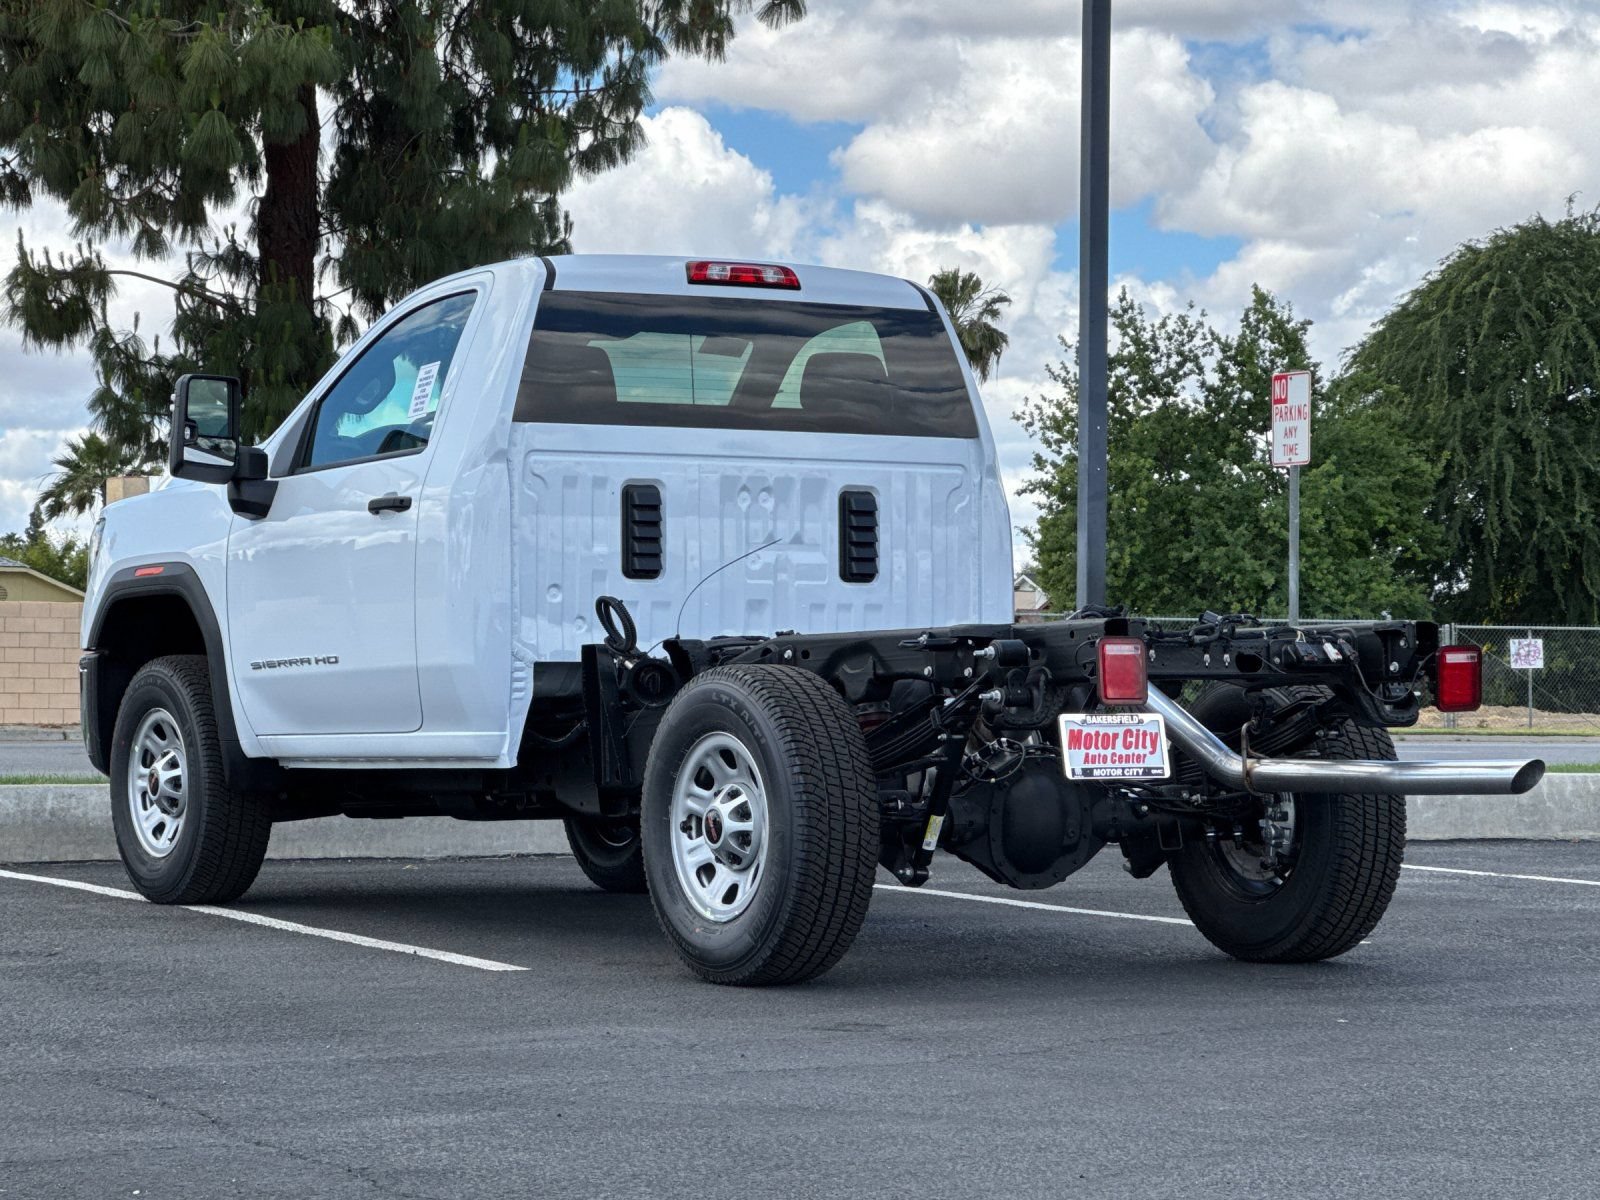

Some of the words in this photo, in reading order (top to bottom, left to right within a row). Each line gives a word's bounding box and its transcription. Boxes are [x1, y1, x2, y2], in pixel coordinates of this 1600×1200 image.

[1274, 379, 1287, 400] NO
[1274, 404, 1308, 423] PARKING
[1283, 426, 1298, 439] ANY
[1282, 443, 1299, 457] TIME
[250, 657, 312, 670] SIERRA
[314, 655, 340, 666] HD
[1086, 715, 1139, 724] BAKERSFIELD
[1067, 728, 1120, 750] Motor
[1122, 728, 1159, 755] City
[1083, 752, 1108, 765] Auto
[1110, 752, 1147, 765] Center
[1093, 768, 1122, 776] MOTOR
[1124, 768, 1144, 776] CITY
